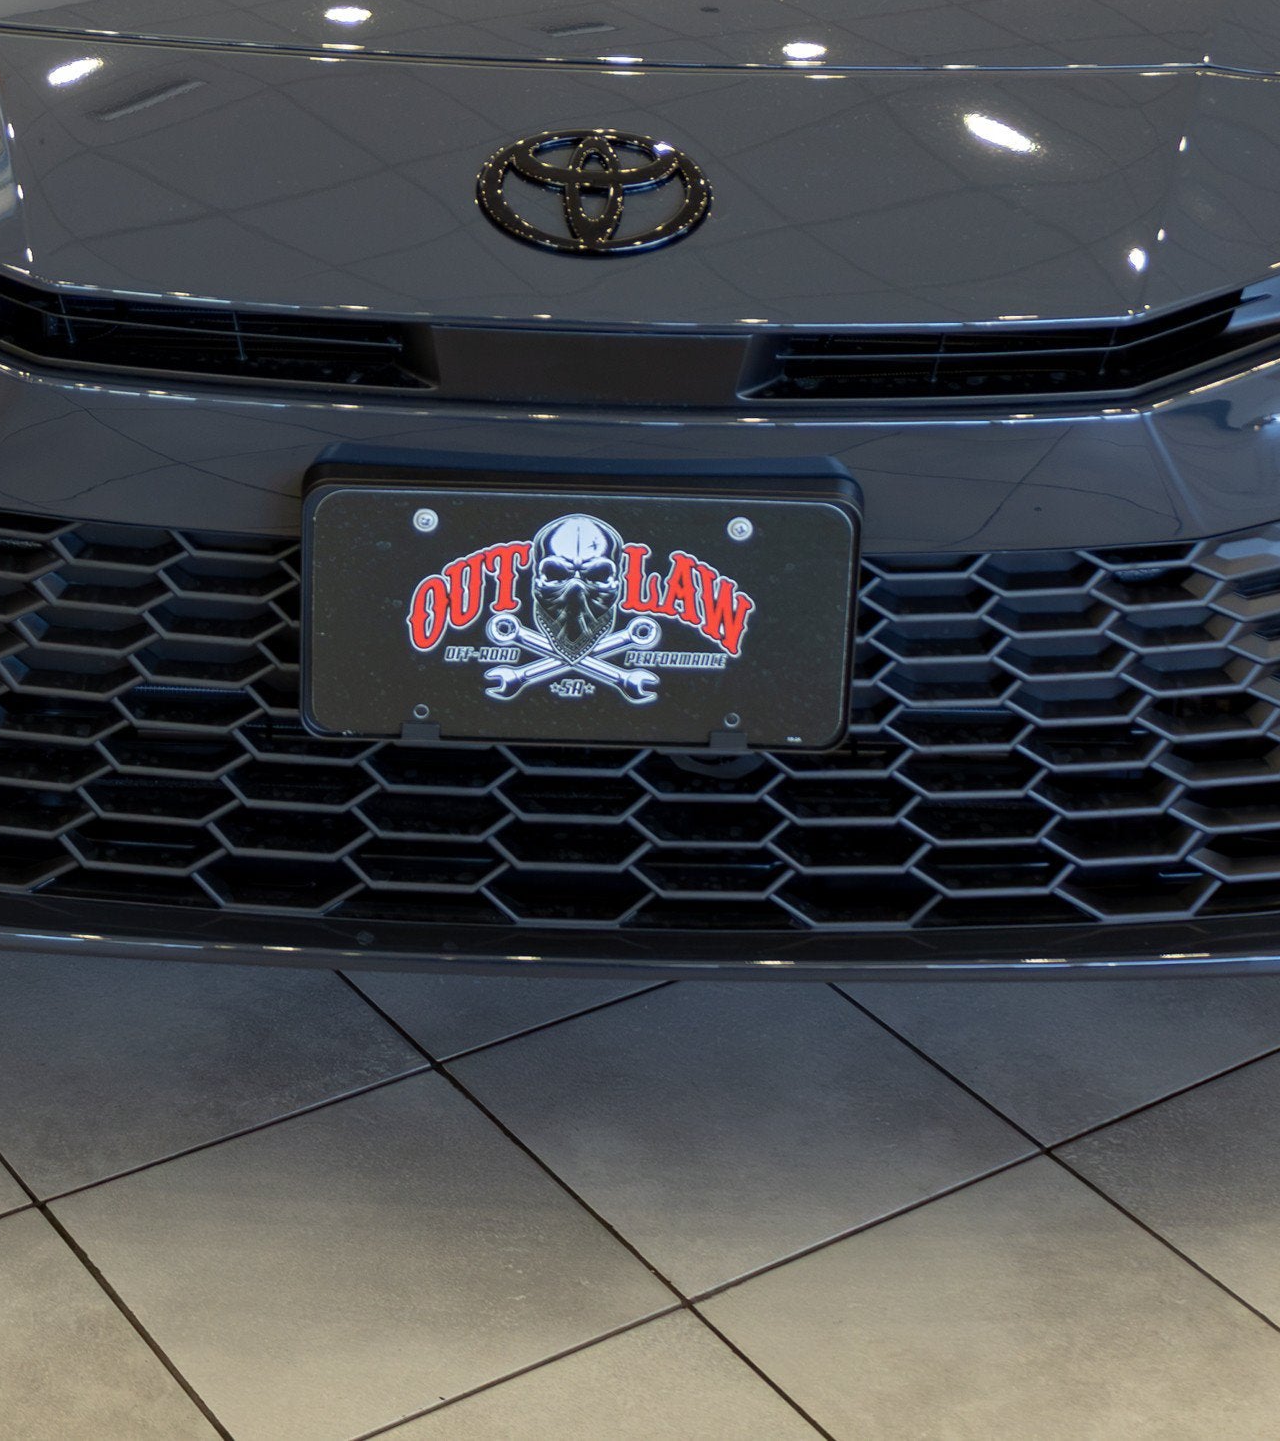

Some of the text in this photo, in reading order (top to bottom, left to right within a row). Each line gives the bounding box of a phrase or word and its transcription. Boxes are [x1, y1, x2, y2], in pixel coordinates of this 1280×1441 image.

[444, 645, 728, 669] OFF-ROAD PERFORMANCE
[558, 678, 586, 697] SA
